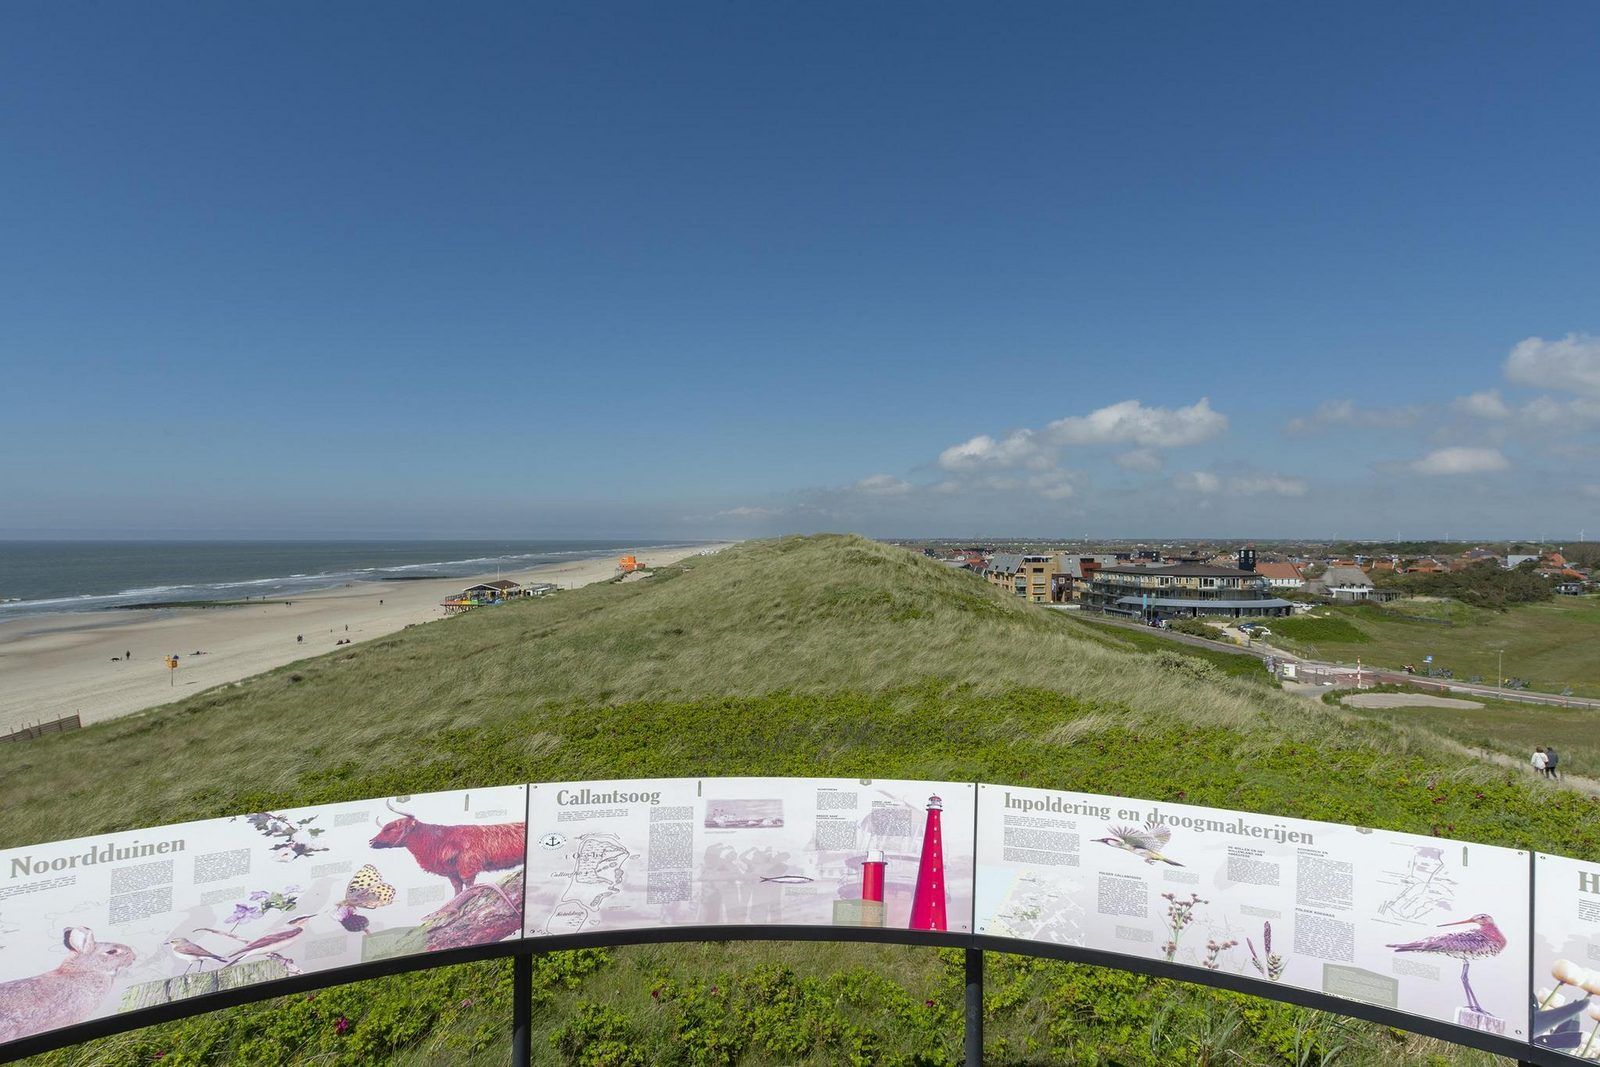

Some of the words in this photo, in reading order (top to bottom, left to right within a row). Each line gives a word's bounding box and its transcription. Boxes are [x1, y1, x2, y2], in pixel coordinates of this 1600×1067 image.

[557, 789, 661, 806] Callantsoog
[1004, 792, 1111, 820] Inpoldering
[1117, 808, 1140, 822] en
[1147, 808, 1314, 845] droogmakerijen
[10, 839, 186, 878] Noordduinen
